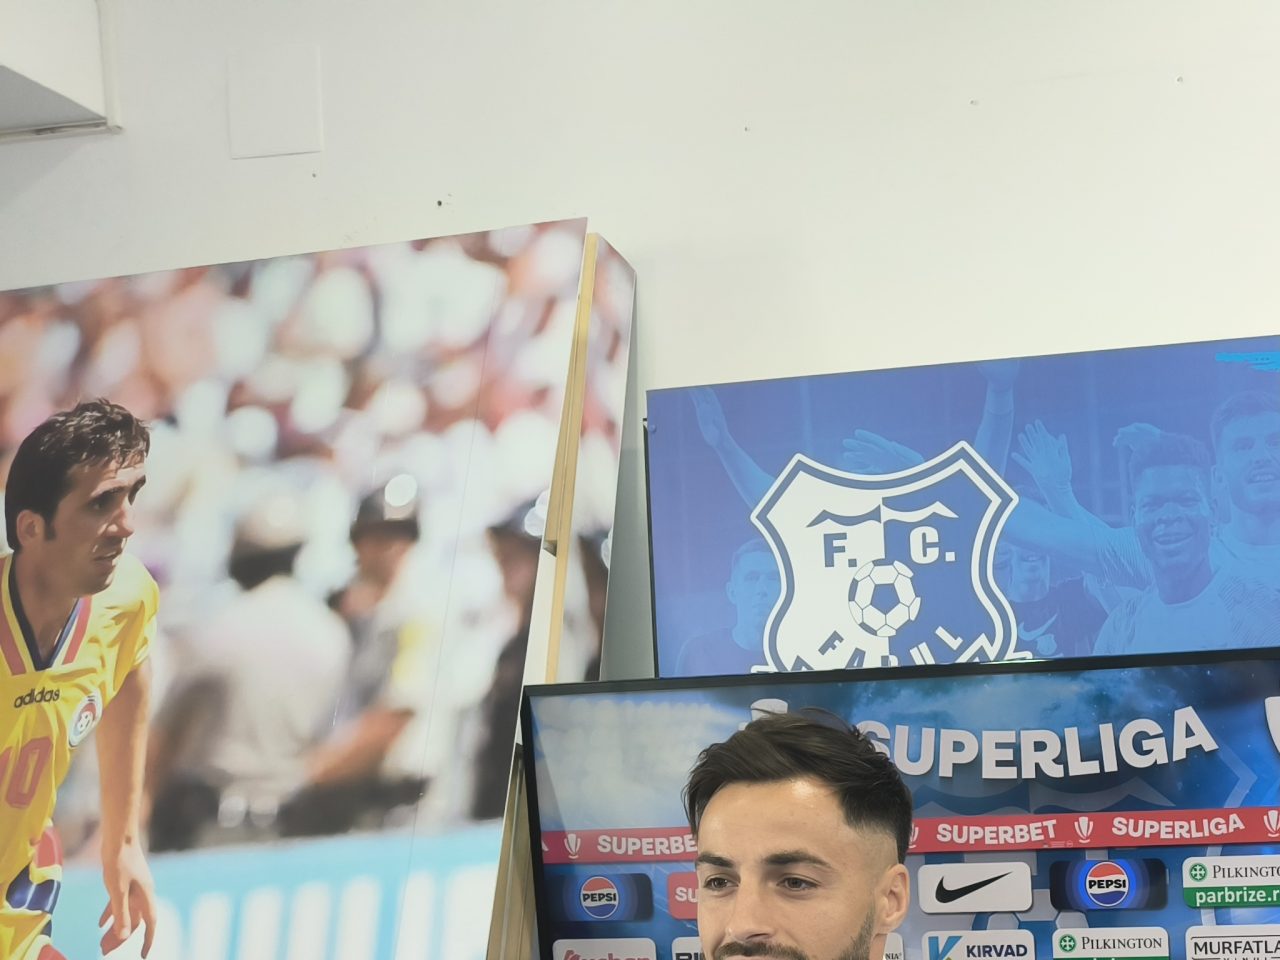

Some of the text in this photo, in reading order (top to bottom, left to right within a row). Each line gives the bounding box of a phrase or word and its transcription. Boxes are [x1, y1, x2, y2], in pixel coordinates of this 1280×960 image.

[13, 687, 60, 708] adidas
[936, 819, 1057, 844] SUPERBET
[1111, 812, 1246, 840] SUPERLIGA
[596, 833, 698, 855] SUPERBE
[1088, 879, 1127, 889] PEPSI
[581, 892, 617, 903] PEPSI
[966, 944, 1028, 958] KIRVAD
